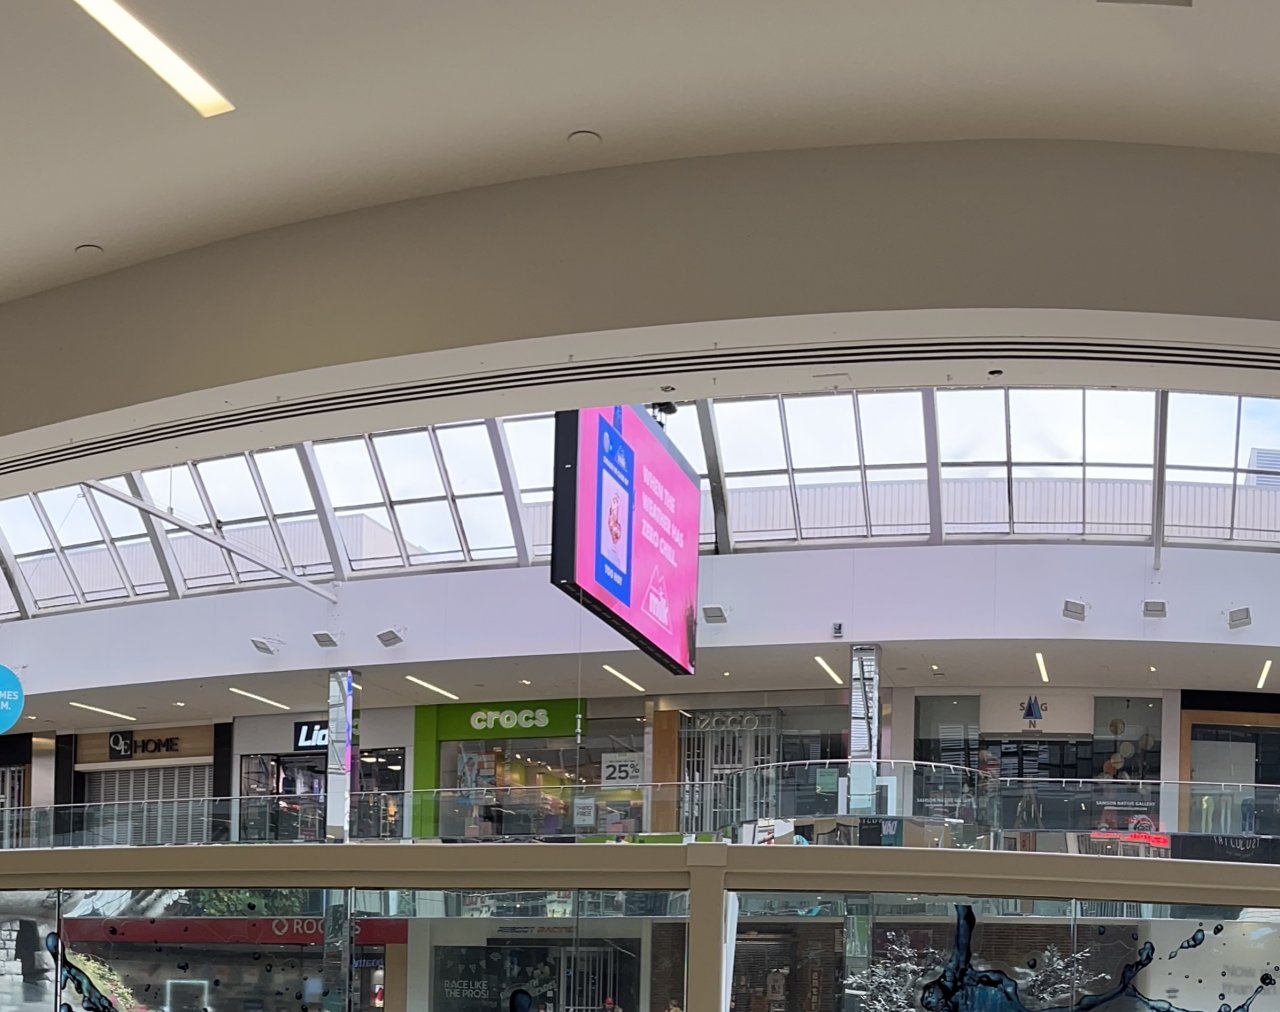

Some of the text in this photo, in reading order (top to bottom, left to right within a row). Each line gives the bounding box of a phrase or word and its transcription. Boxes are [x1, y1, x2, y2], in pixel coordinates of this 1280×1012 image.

[470, 709, 549, 730] crocs
[133, 736, 179, 754] HOME
[605, 764, 640, 780] 25%
[293, 918, 362, 934] ROS
[444, 979, 488, 990] RACE LIKE
[445, 989, 461, 998] THE
